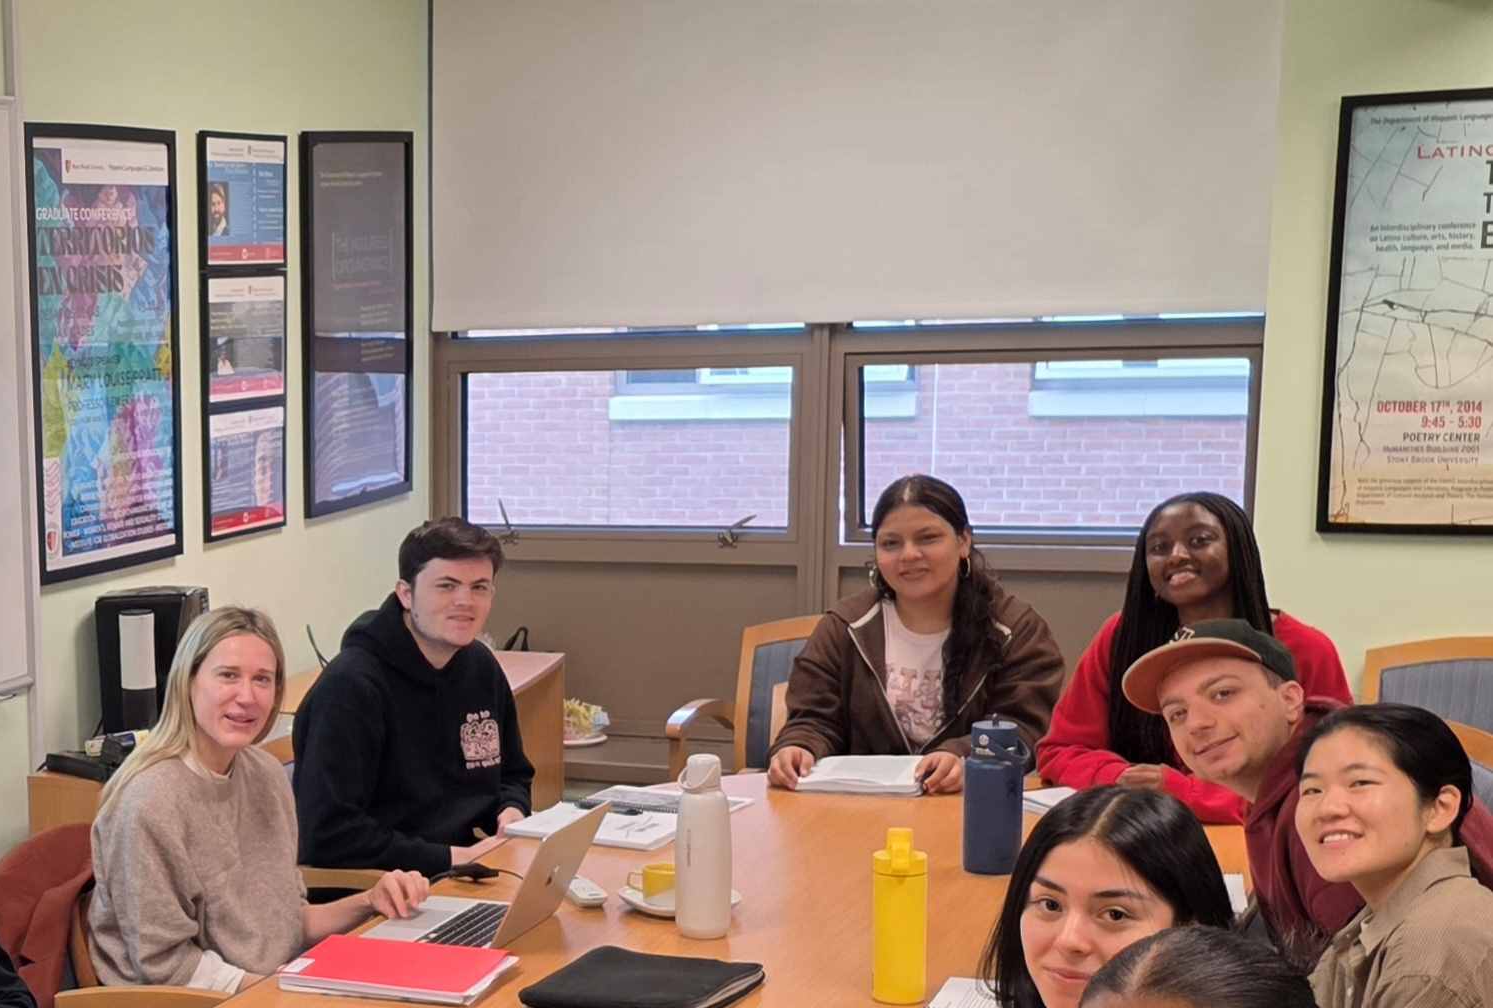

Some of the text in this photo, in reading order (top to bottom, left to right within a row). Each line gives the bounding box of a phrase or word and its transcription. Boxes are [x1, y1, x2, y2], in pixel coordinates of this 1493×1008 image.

[1376, 400, 1427, 413] OCTOBER
[1457, 400, 1482, 413] 2014
[1421, 415, 1446, 428] 9:45
[1458, 415, 1482, 429] 5:30
[1402, 431, 1481, 442] POETRY CENTER
